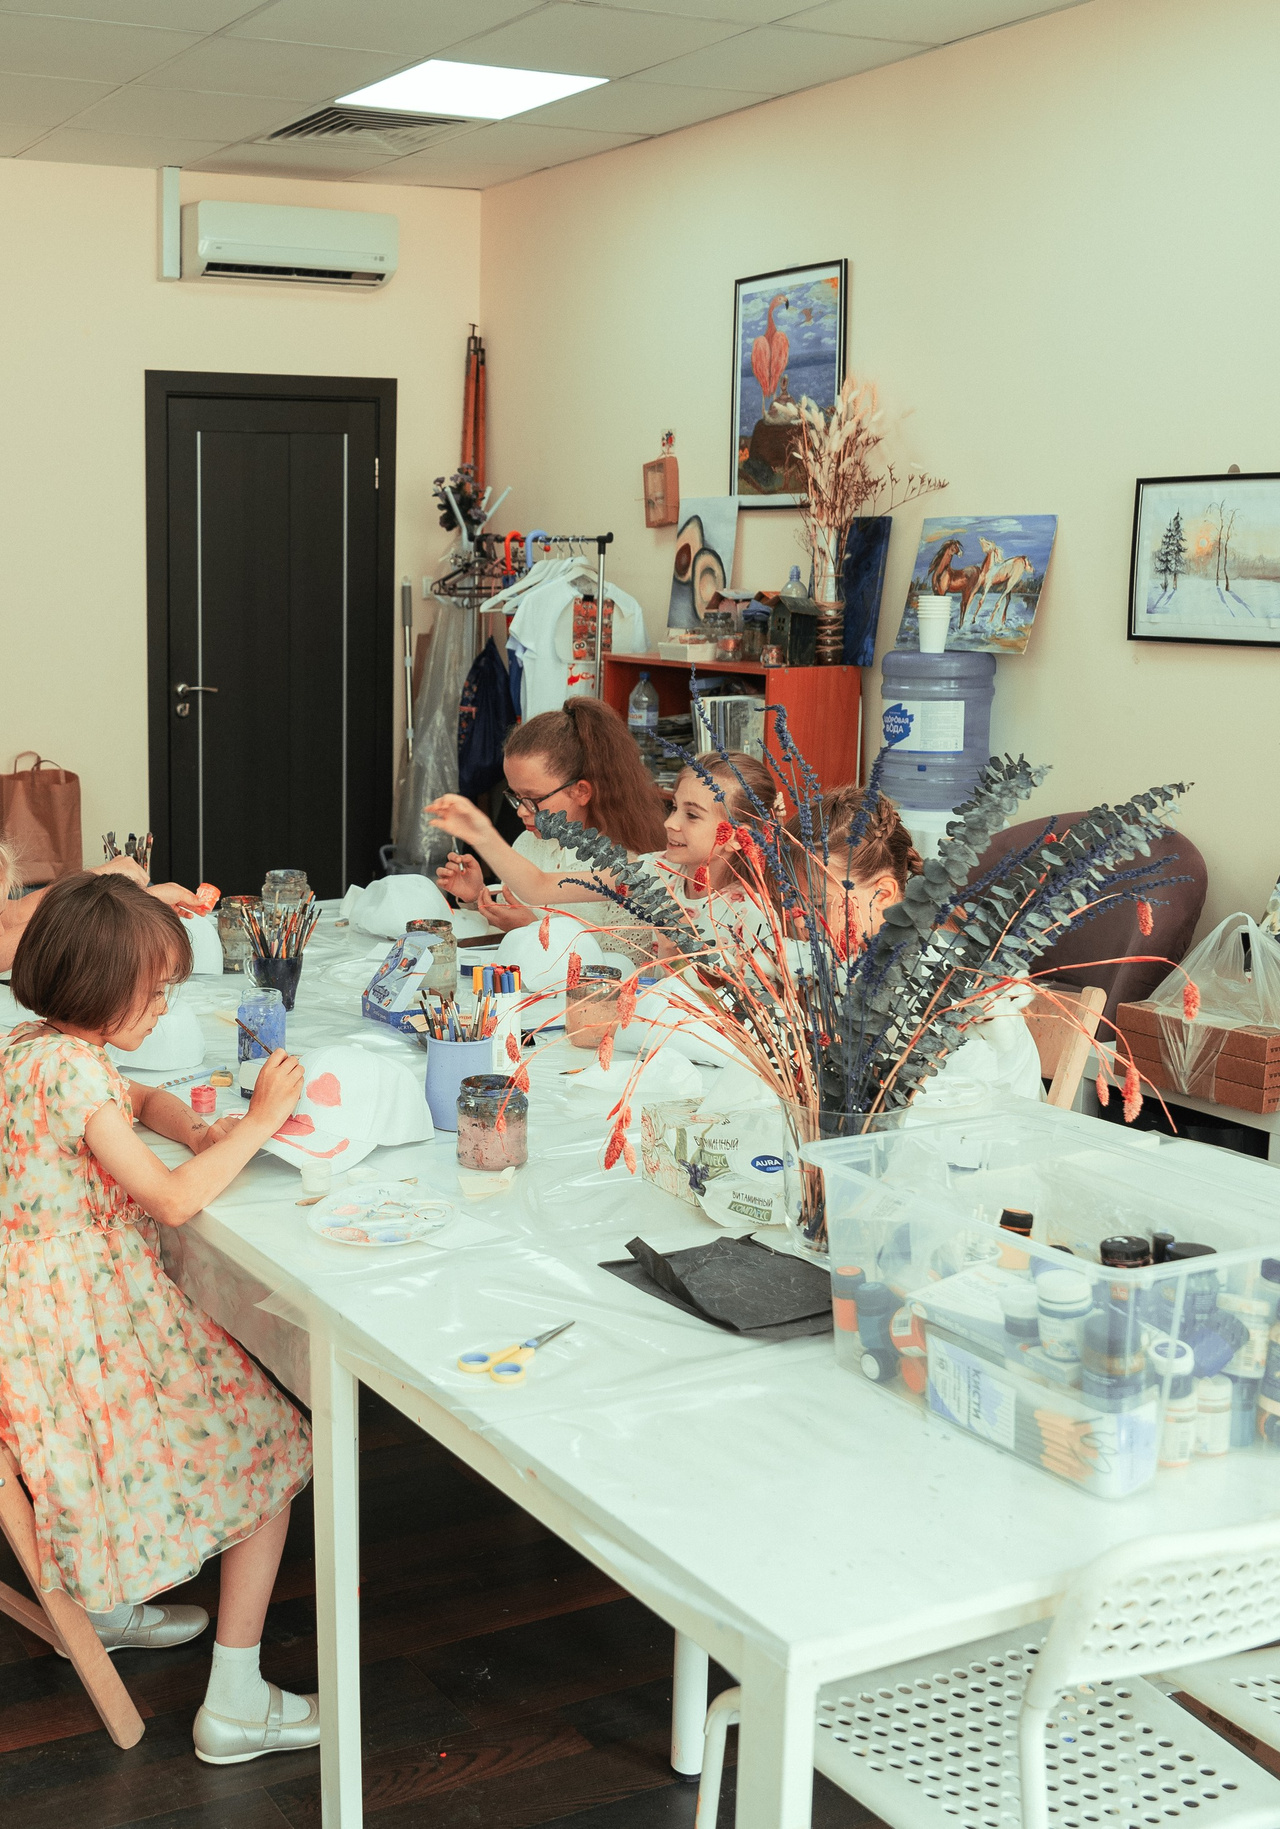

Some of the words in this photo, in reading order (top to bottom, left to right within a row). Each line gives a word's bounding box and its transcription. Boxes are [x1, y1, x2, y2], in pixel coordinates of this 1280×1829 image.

[886, 723, 904, 734] ВОДА
[755, 1158, 781, 1167] AURA
[732, 1190, 773, 1208] ВИТАМИННЫЙ
[730, 1202, 771, 1222] КОМПЛЕКС
[971, 1367, 982, 1420] КИСТИ
